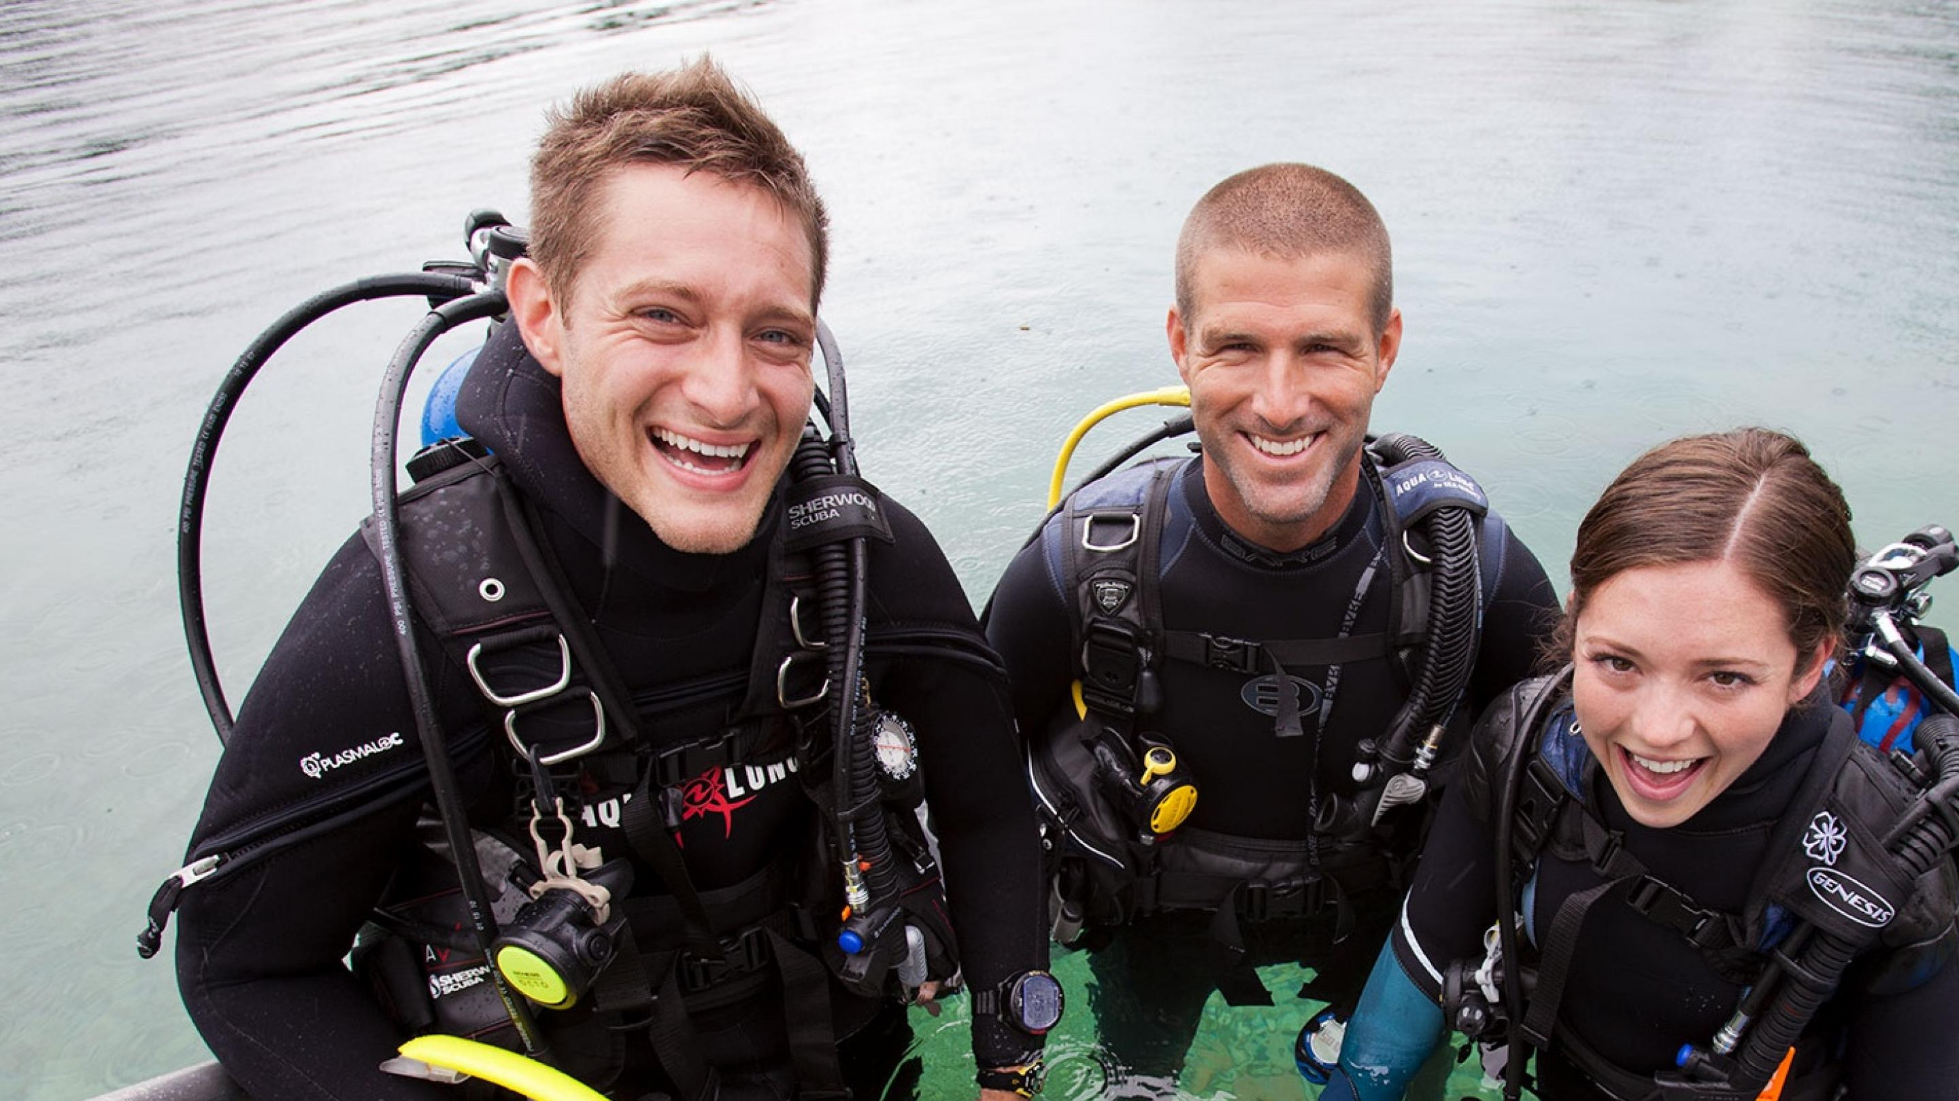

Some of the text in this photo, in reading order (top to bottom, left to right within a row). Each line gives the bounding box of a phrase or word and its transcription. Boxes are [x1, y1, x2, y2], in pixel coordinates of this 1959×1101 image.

[1396, 473, 1427, 497] AQUA
[791, 508, 840, 530] SCUBA
[378, 520, 391, 551] TESTED
[383, 553, 400, 599] PRESSURE
[1813, 871, 1891, 922] GENESIS
[439, 964, 491, 986] SHERW
[442, 977, 484, 995] SCUBA
